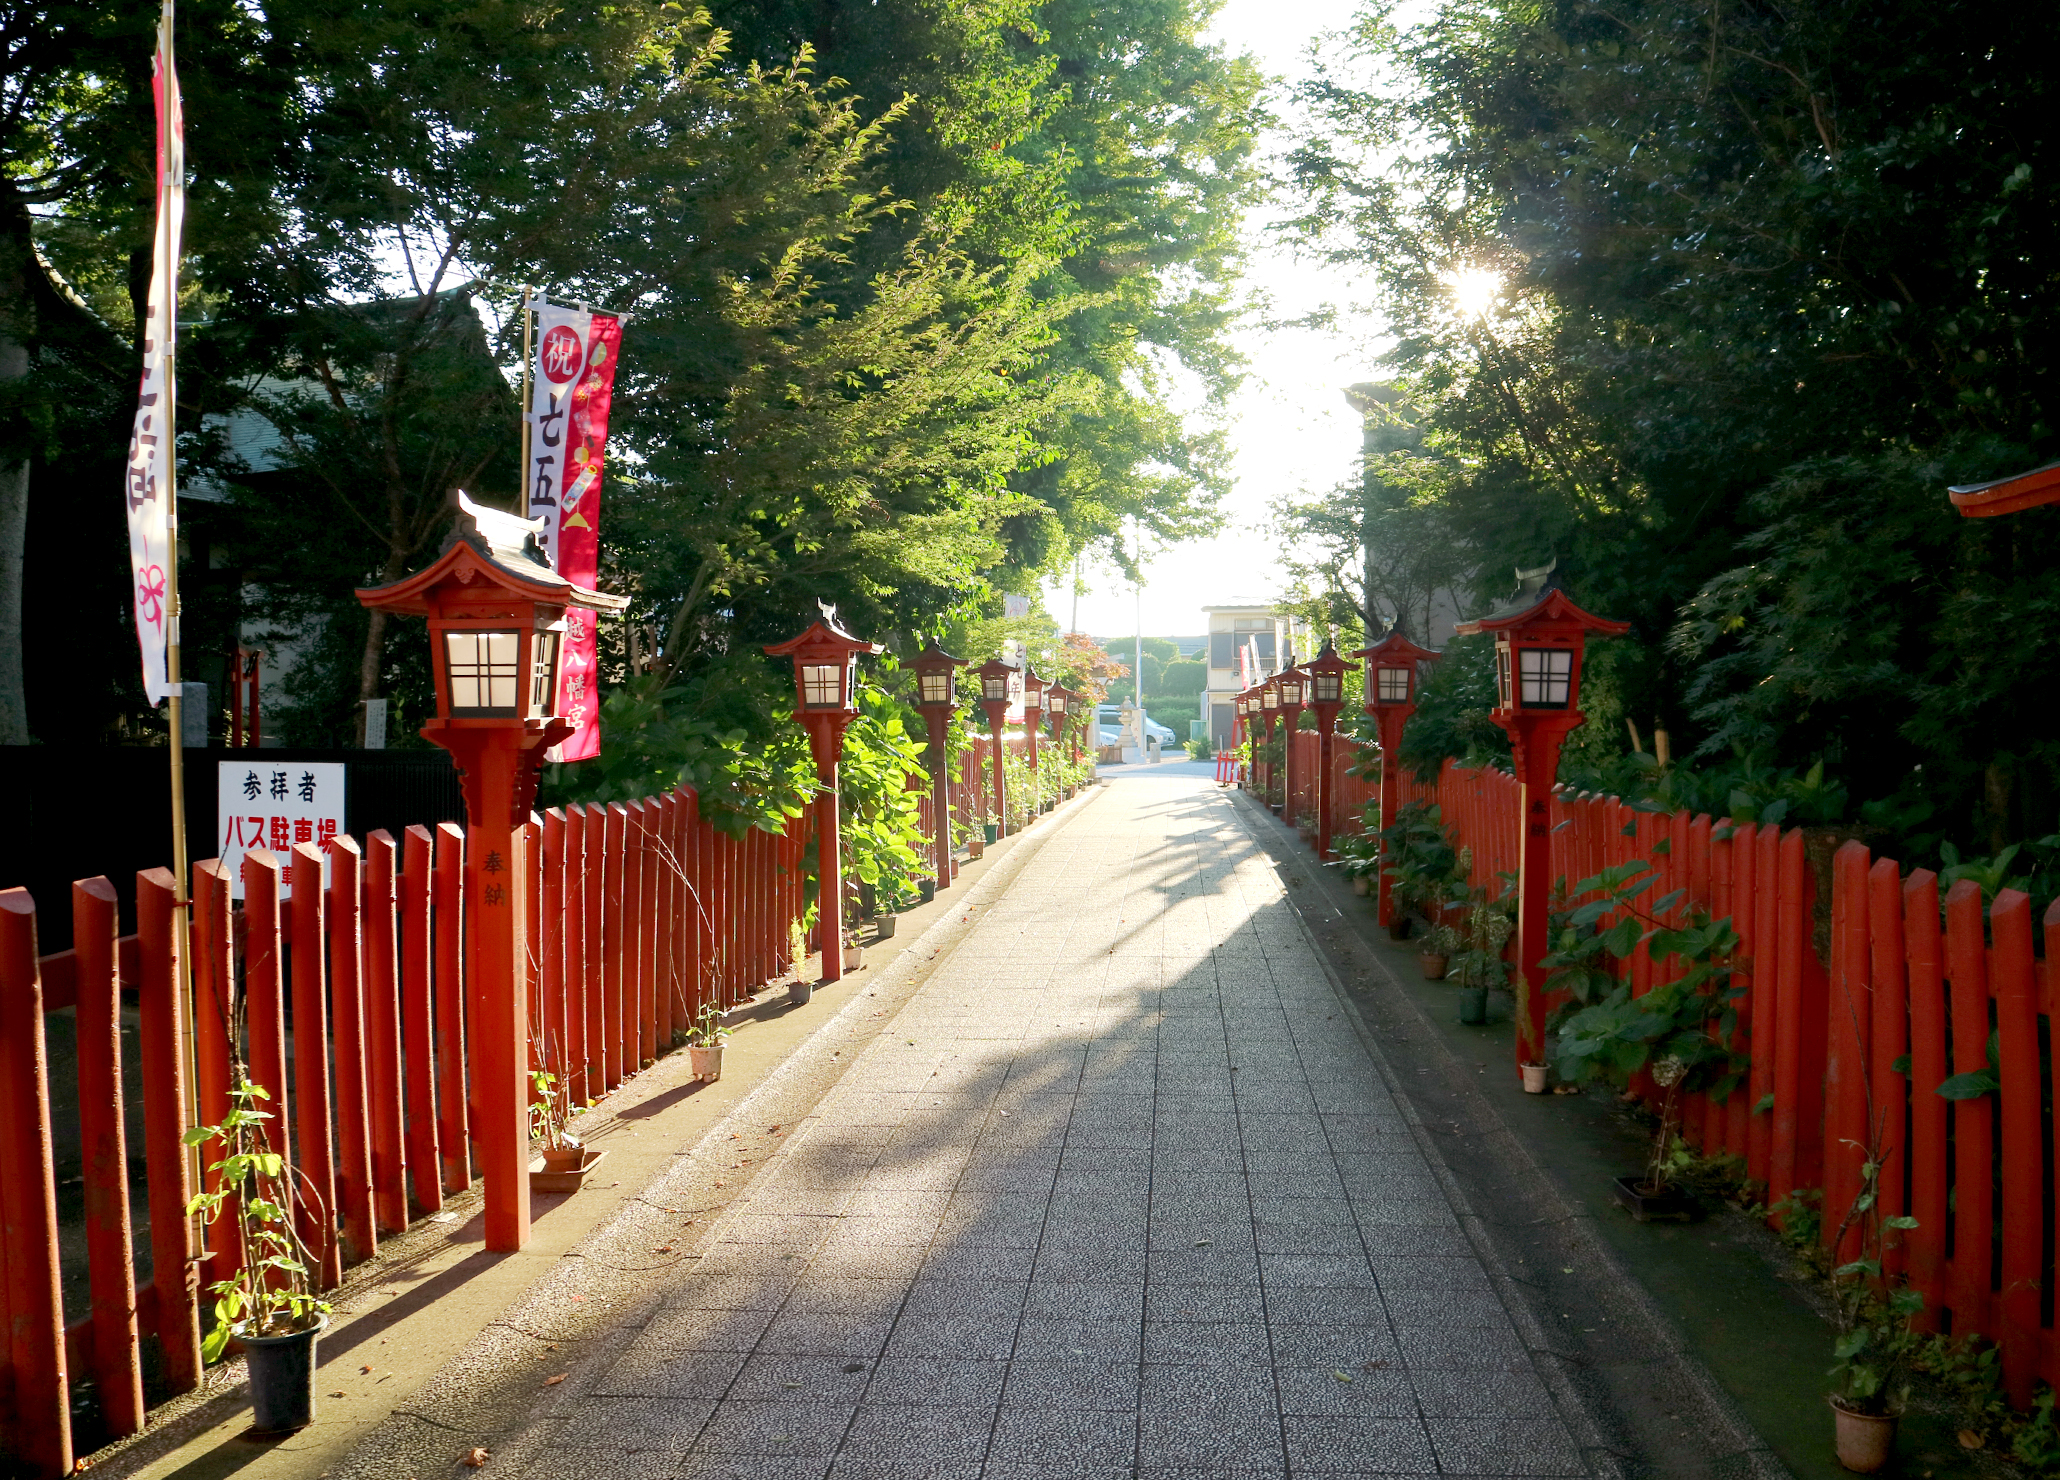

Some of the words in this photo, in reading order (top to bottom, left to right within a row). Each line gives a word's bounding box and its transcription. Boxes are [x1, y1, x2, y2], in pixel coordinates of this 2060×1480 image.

[545, 332, 576, 376] 祝
[564, 608, 588, 731] 越八幡宮
[243, 769, 317, 803] 参拝者
[225, 815, 338, 855] バス駐車場
[482, 849, 507, 907] 奉納
